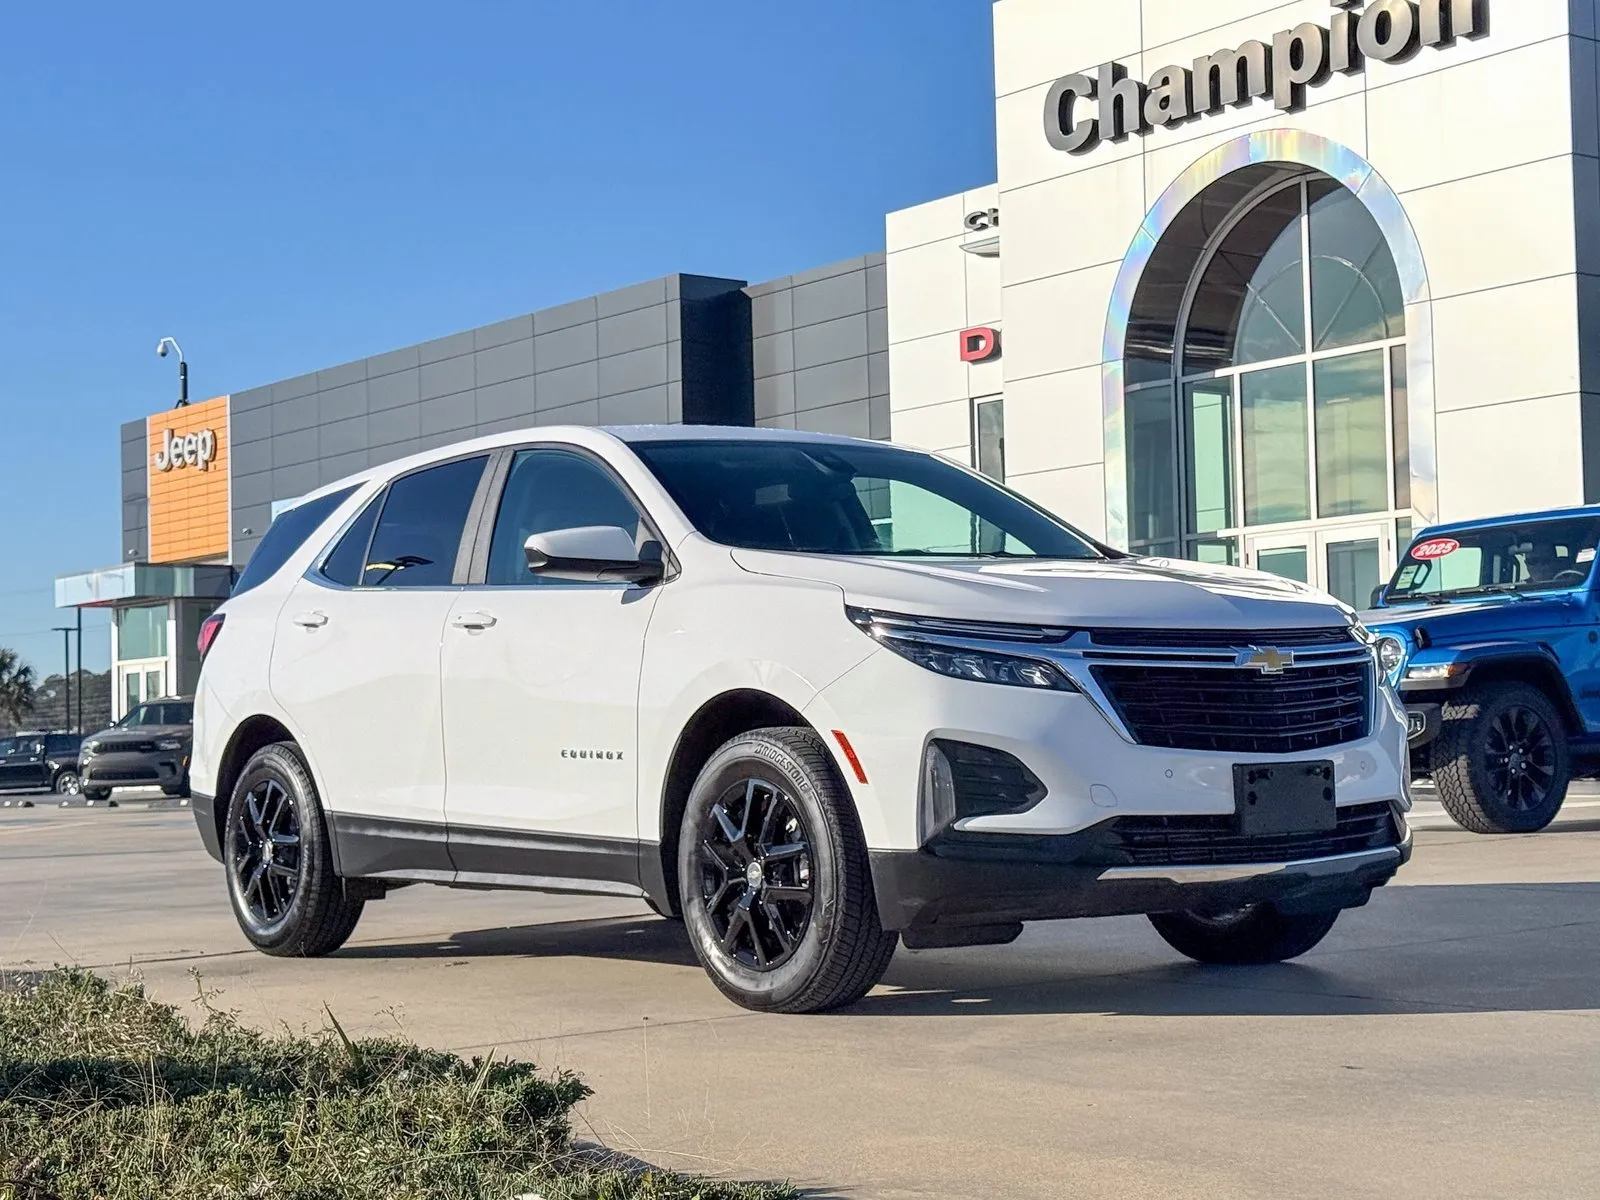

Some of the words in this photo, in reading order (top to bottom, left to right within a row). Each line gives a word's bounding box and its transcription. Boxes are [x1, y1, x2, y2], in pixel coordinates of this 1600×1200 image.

[1043, 0, 1485, 154] Champion
[154, 428, 216, 472] Jeep
[1414, 542, 1456, 557] 2025
[561, 749, 624, 760] EQUINOX
[754, 742, 809, 792] BRIDGESTONE
